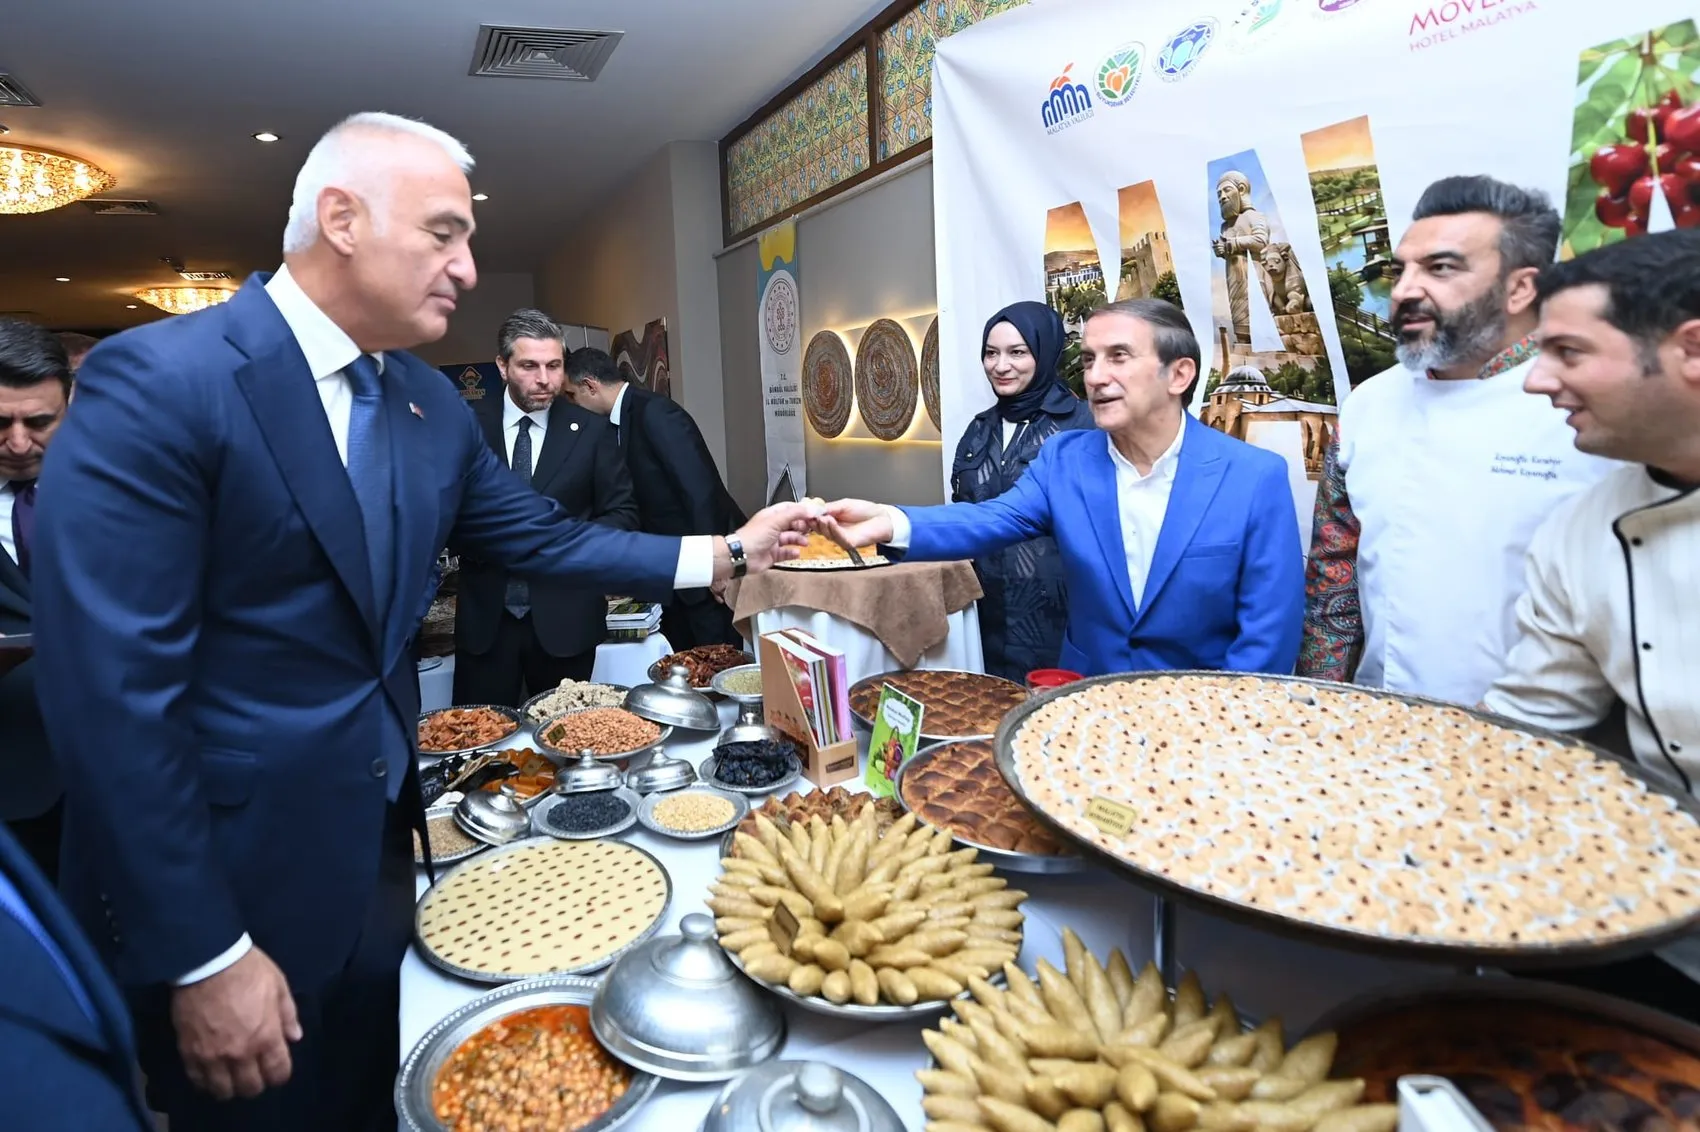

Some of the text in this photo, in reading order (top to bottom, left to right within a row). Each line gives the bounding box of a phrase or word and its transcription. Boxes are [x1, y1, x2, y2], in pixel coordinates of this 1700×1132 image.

[1409, 0, 1537, 52] HOTEL MALATYA
[1046, 119, 1071, 135] MALATYA
